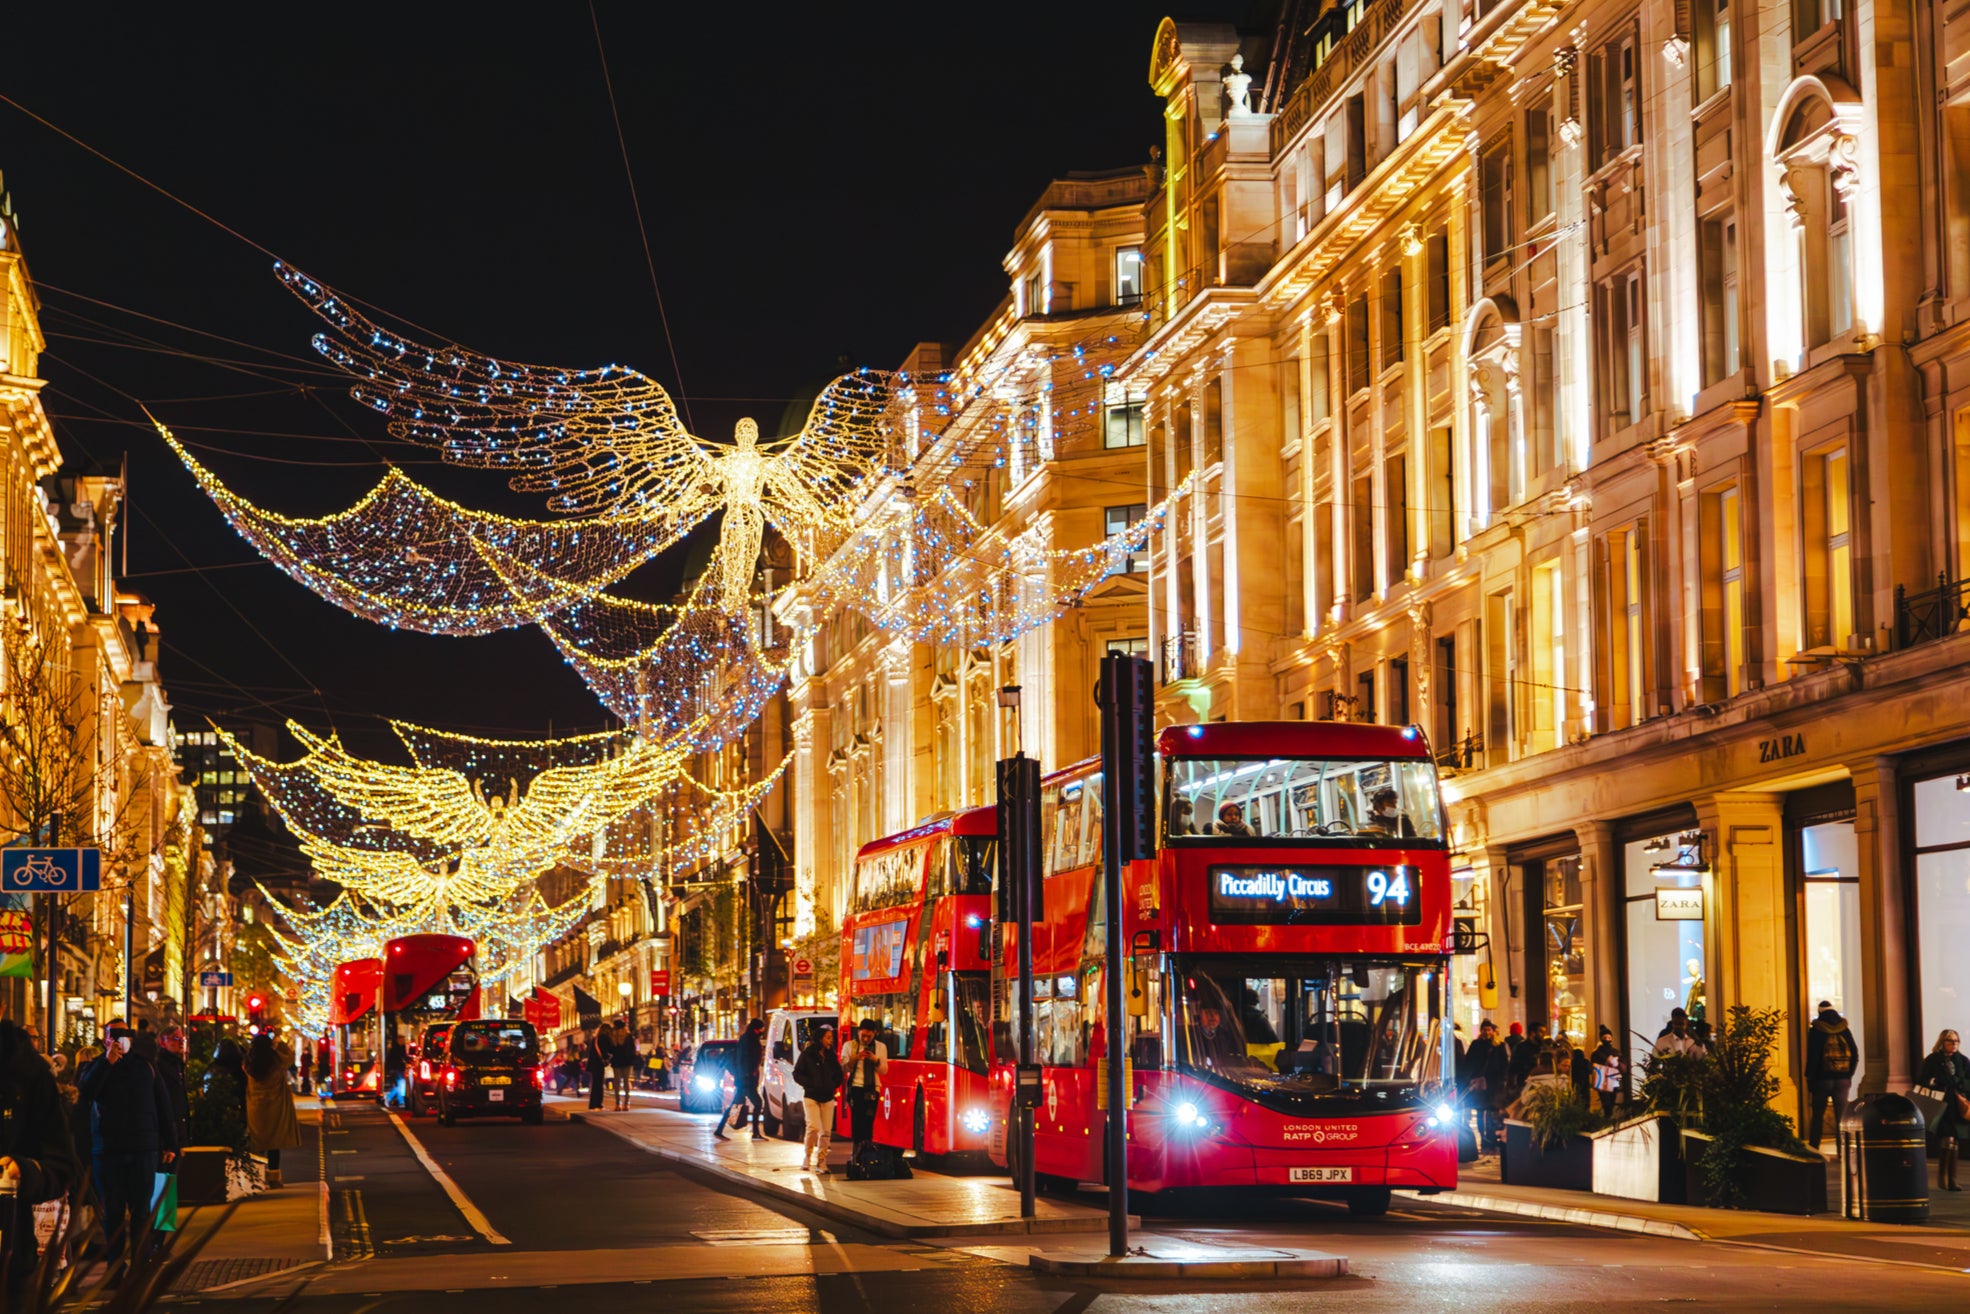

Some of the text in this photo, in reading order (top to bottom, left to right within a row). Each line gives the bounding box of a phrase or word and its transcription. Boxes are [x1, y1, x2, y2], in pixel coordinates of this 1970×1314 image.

[1759, 733, 1806, 763] ZARA
[1221, 873, 1329, 901] Piccadilly Circus
[1367, 871, 1409, 905] 94
[1660, 900, 1700, 909] ZARA
[1404, 943, 1418, 951] BCE
[1283, 1132, 1358, 1141] RATP GROUP
[1294, 1169, 1347, 1180] LB69 JPX
